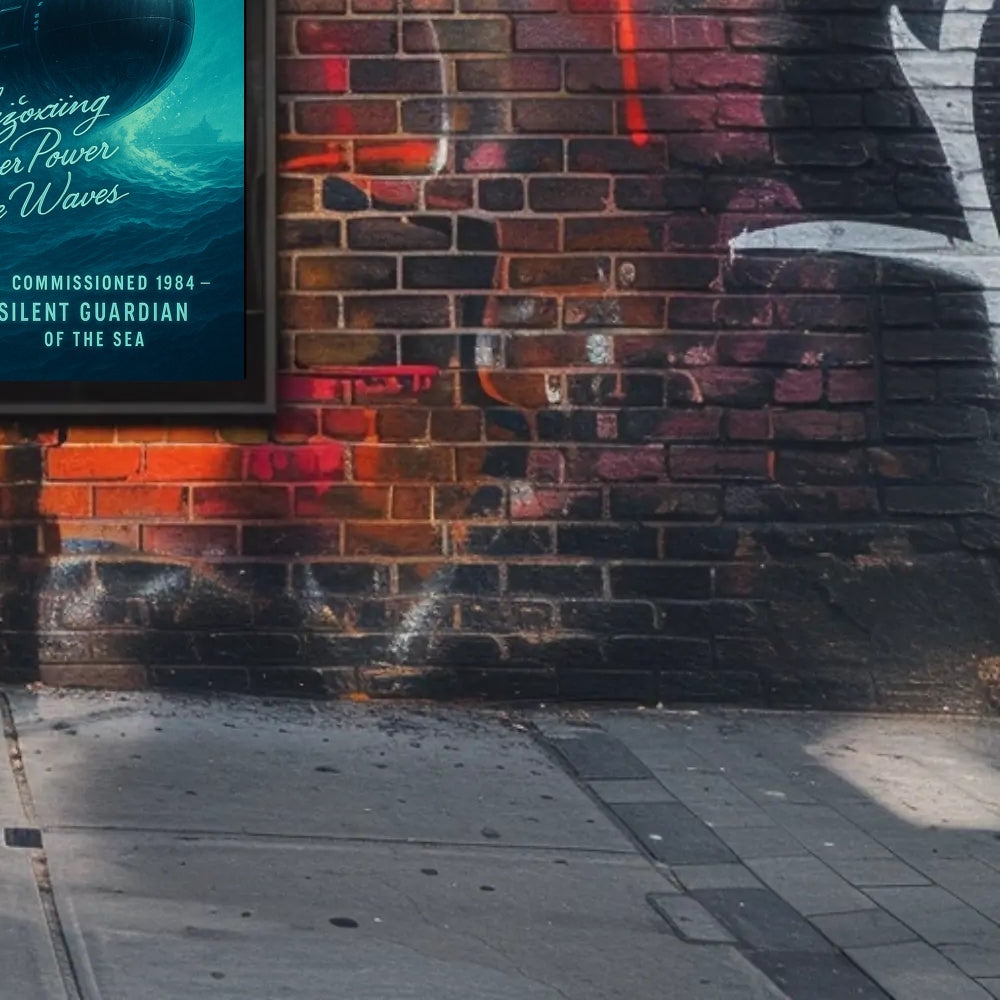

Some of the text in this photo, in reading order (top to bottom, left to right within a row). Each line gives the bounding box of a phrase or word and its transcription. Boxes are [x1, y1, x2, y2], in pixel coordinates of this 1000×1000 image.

[10, 127, 120, 174] Power
[9, 172, 129, 218] Waves
[12, 274, 148, 291] COMMISSIONED
[79, 302, 188, 322] GUARDIAN
[44, 331, 145, 348] OF THE SEA
